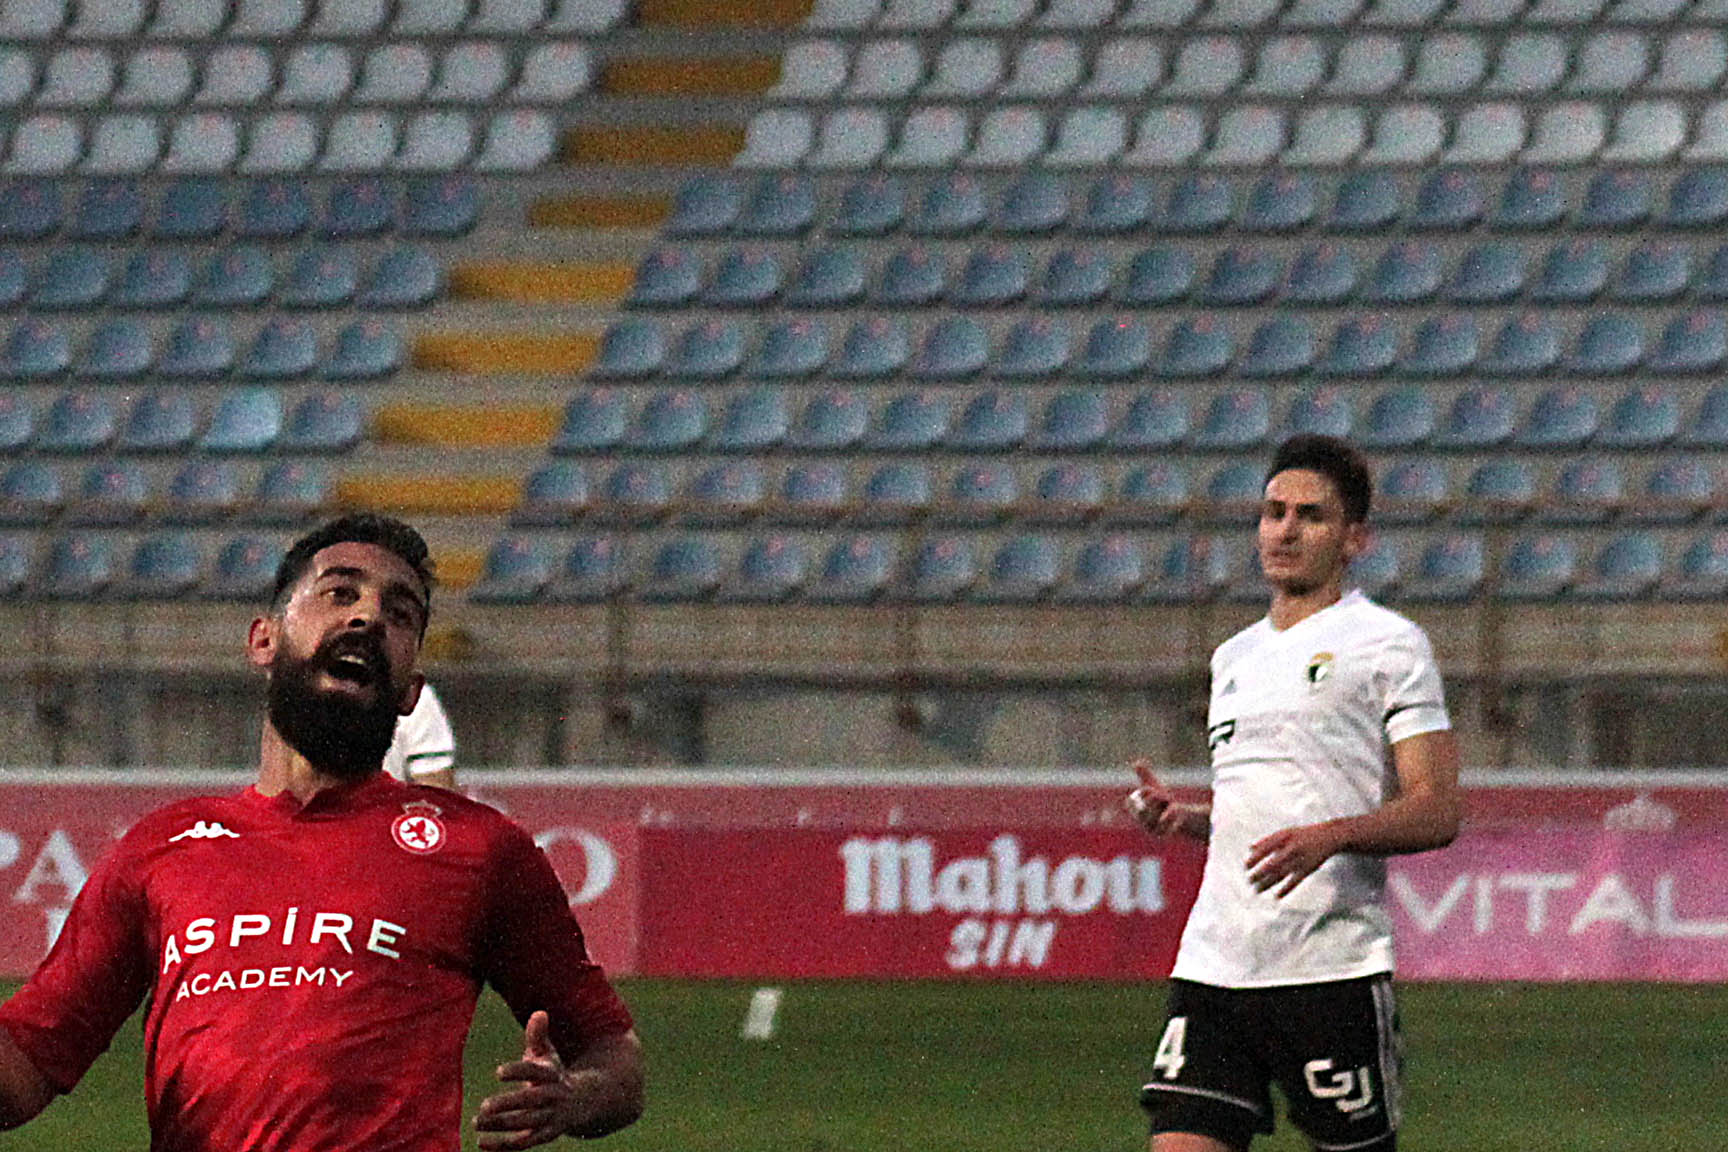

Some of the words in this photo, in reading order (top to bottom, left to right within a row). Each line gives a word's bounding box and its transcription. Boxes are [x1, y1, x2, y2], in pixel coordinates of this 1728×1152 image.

[839, 834, 1165, 914] Mahou
[162, 907, 407, 975] ASPIRE
[947, 918, 1058, 970] SIN
[175, 966, 354, 1003] ACADEMY
[1153, 1016, 1188, 1080] 4
